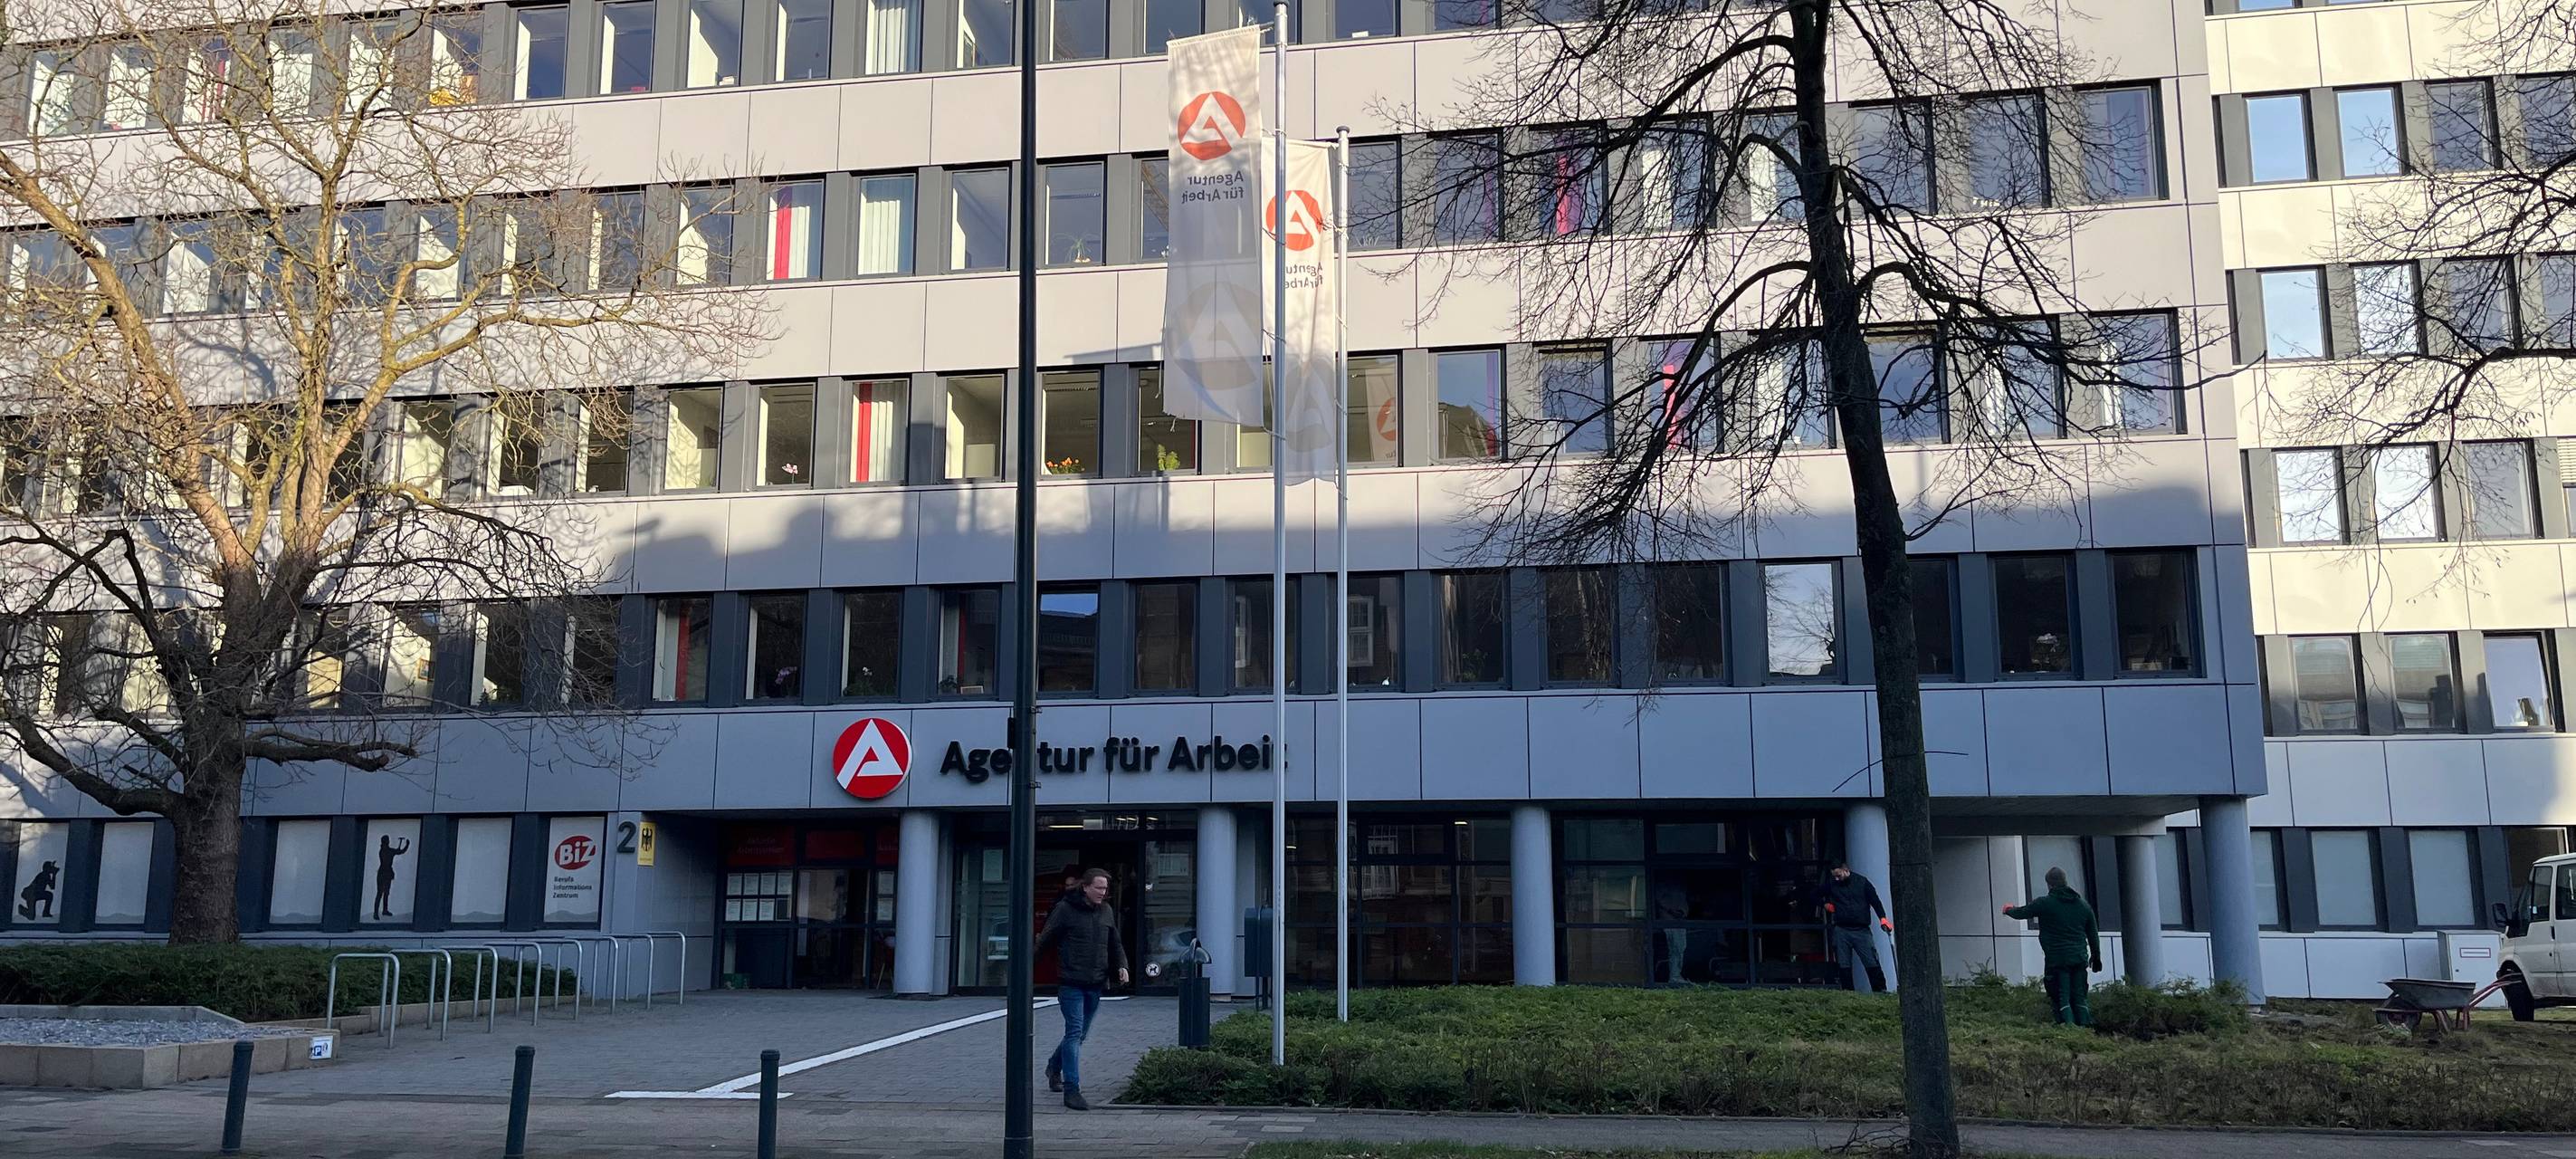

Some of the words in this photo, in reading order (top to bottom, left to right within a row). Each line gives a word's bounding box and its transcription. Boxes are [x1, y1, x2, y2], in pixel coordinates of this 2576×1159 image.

[940, 741, 1094, 783] Agetur
[1103, 736, 1160, 771] für
[559, 840, 596, 866] BiZ
[616, 821, 636, 854] 2
